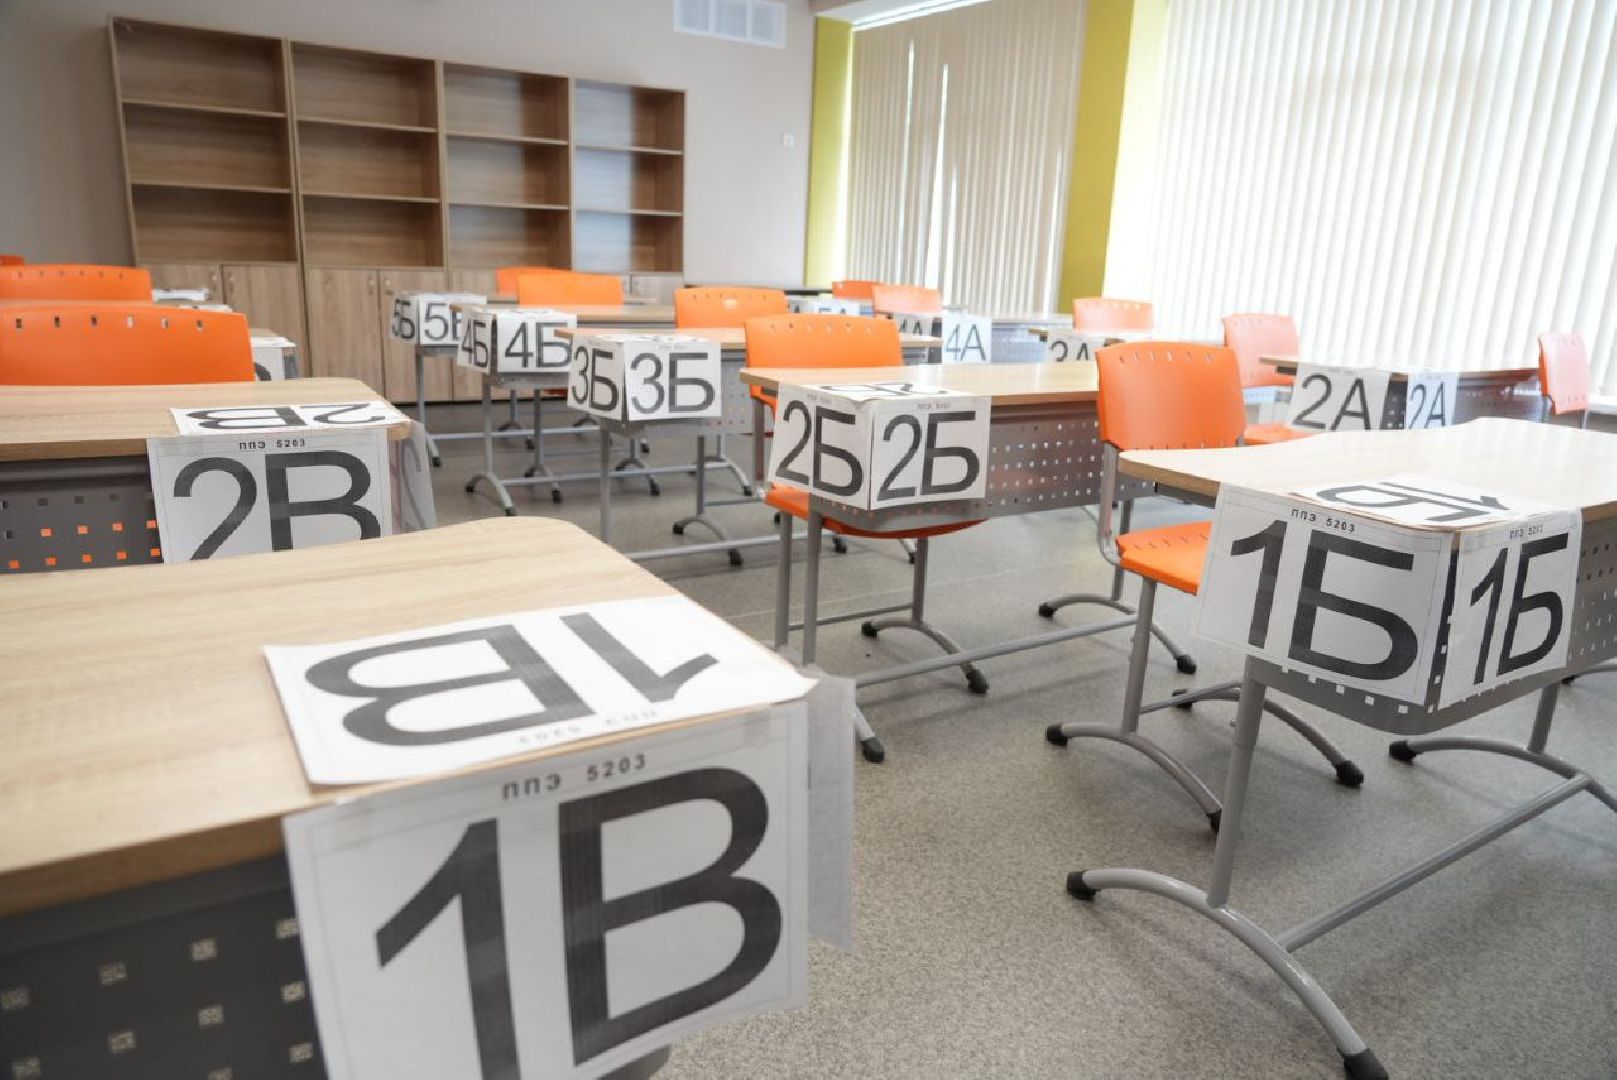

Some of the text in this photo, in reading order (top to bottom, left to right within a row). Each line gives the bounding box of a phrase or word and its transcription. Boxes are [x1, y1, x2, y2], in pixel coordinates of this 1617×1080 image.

[392, 299, 415, 339] 5Б
[461, 318, 489, 367] 4Б
[505, 322, 572, 368] 4Б
[946, 324, 986, 361] 4А
[572, 346, 619, 411] 3Б
[630, 352, 715, 414] 3Б
[1293, 374, 1371, 430] 2А
[1409, 381, 1446, 429] 2А
[276, 438, 305, 449] 5203
[775, 400, 863, 496] 2Б
[877, 410, 980, 501] 2Б
[174, 450, 381, 560] 2В
[1291, 508, 1355, 533] ППЭ 5203
[1230, 520, 1418, 680] 1Б
[1470, 533, 1569, 685] 1Б
[305, 612, 720, 746] 1В
[503, 754, 645, 800] ППЭ 5203
[375, 766, 782, 1080] 1В
